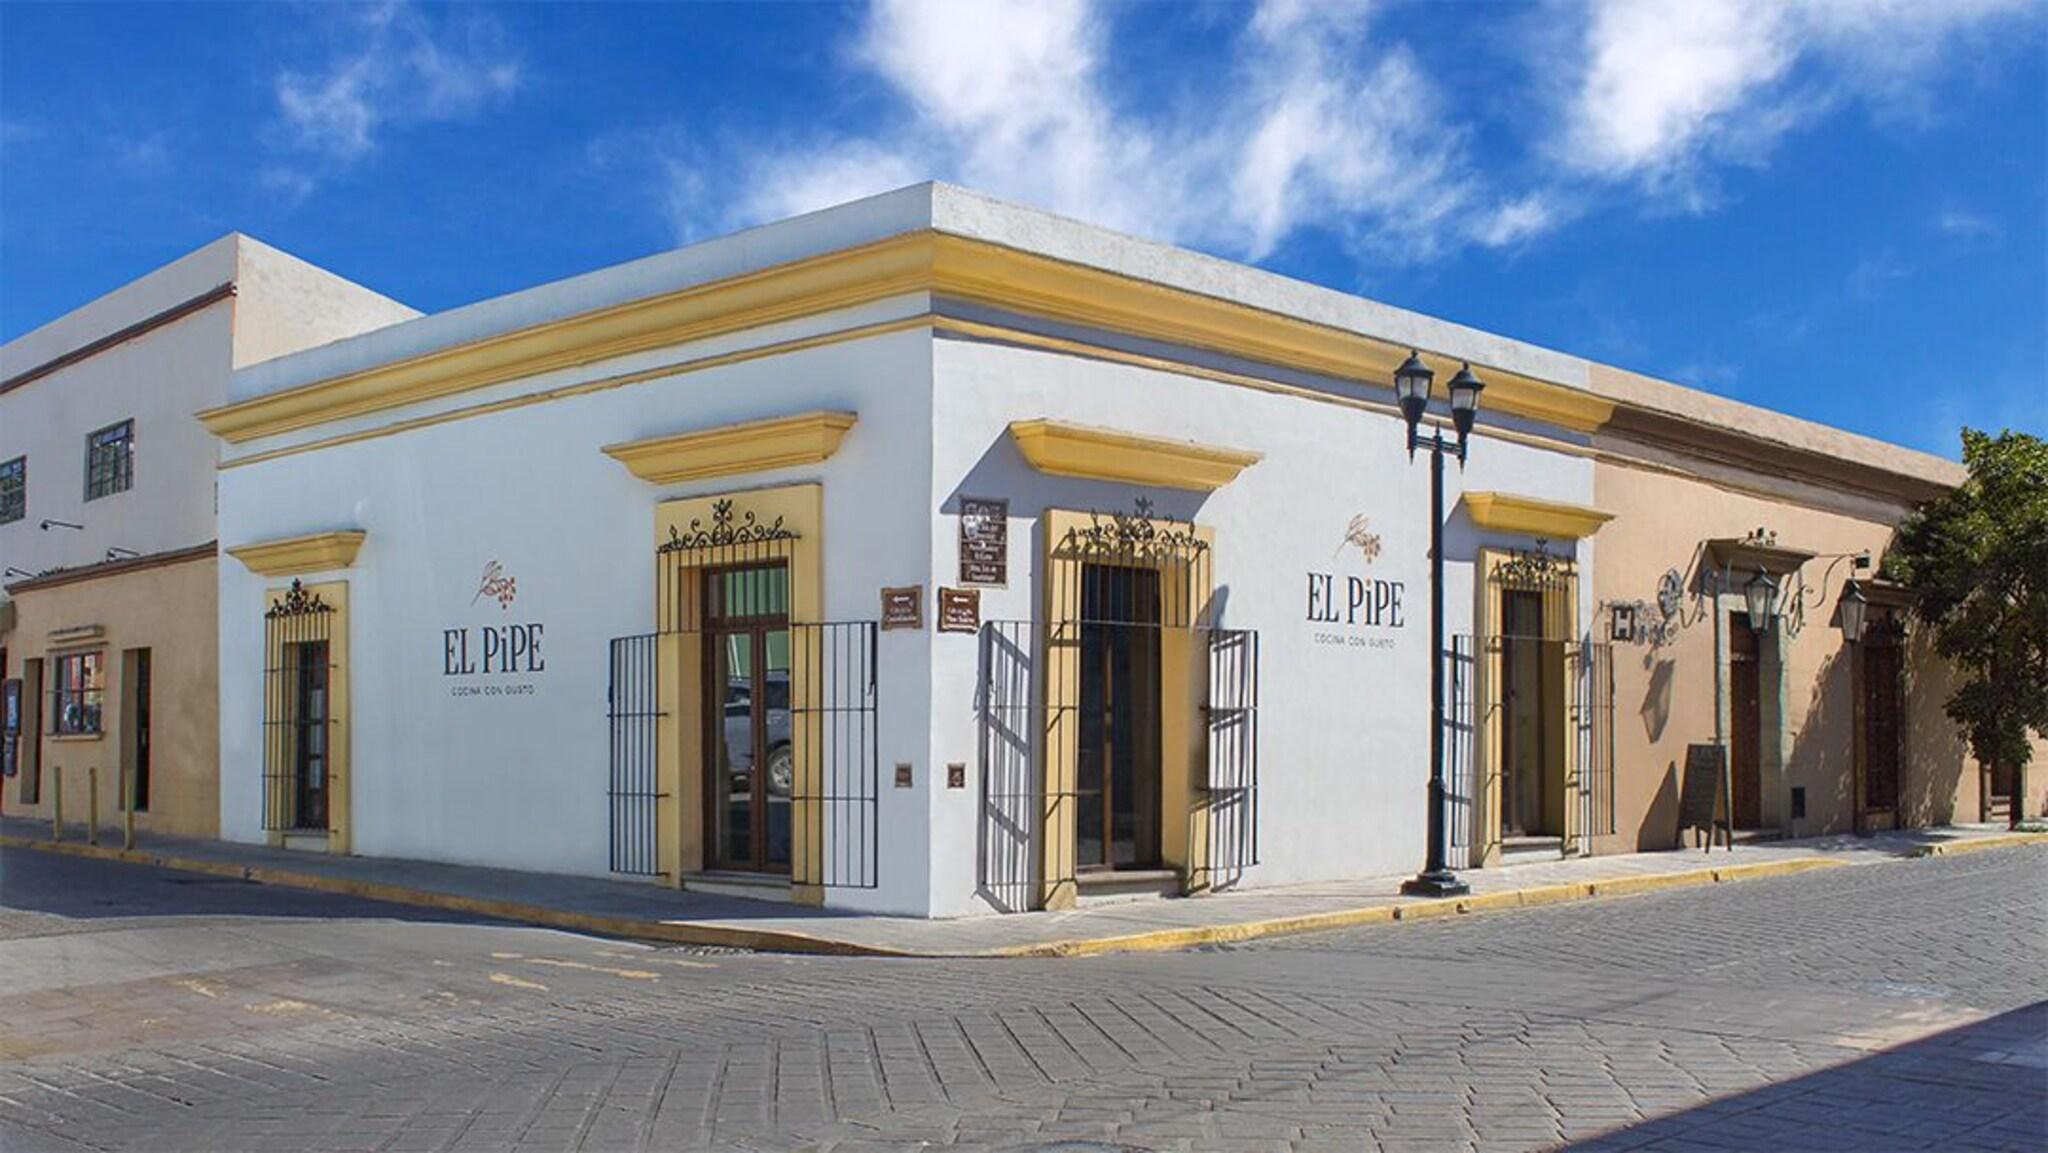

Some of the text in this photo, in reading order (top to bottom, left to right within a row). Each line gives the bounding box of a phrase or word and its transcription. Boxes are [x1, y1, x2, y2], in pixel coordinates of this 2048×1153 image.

[1306, 572, 1339, 622] EL
[443, 628, 476, 675] EL
[1314, 633, 1396, 648] COCINA CON GUSTO
[451, 684, 535, 696] COCINA CON GUSTO
